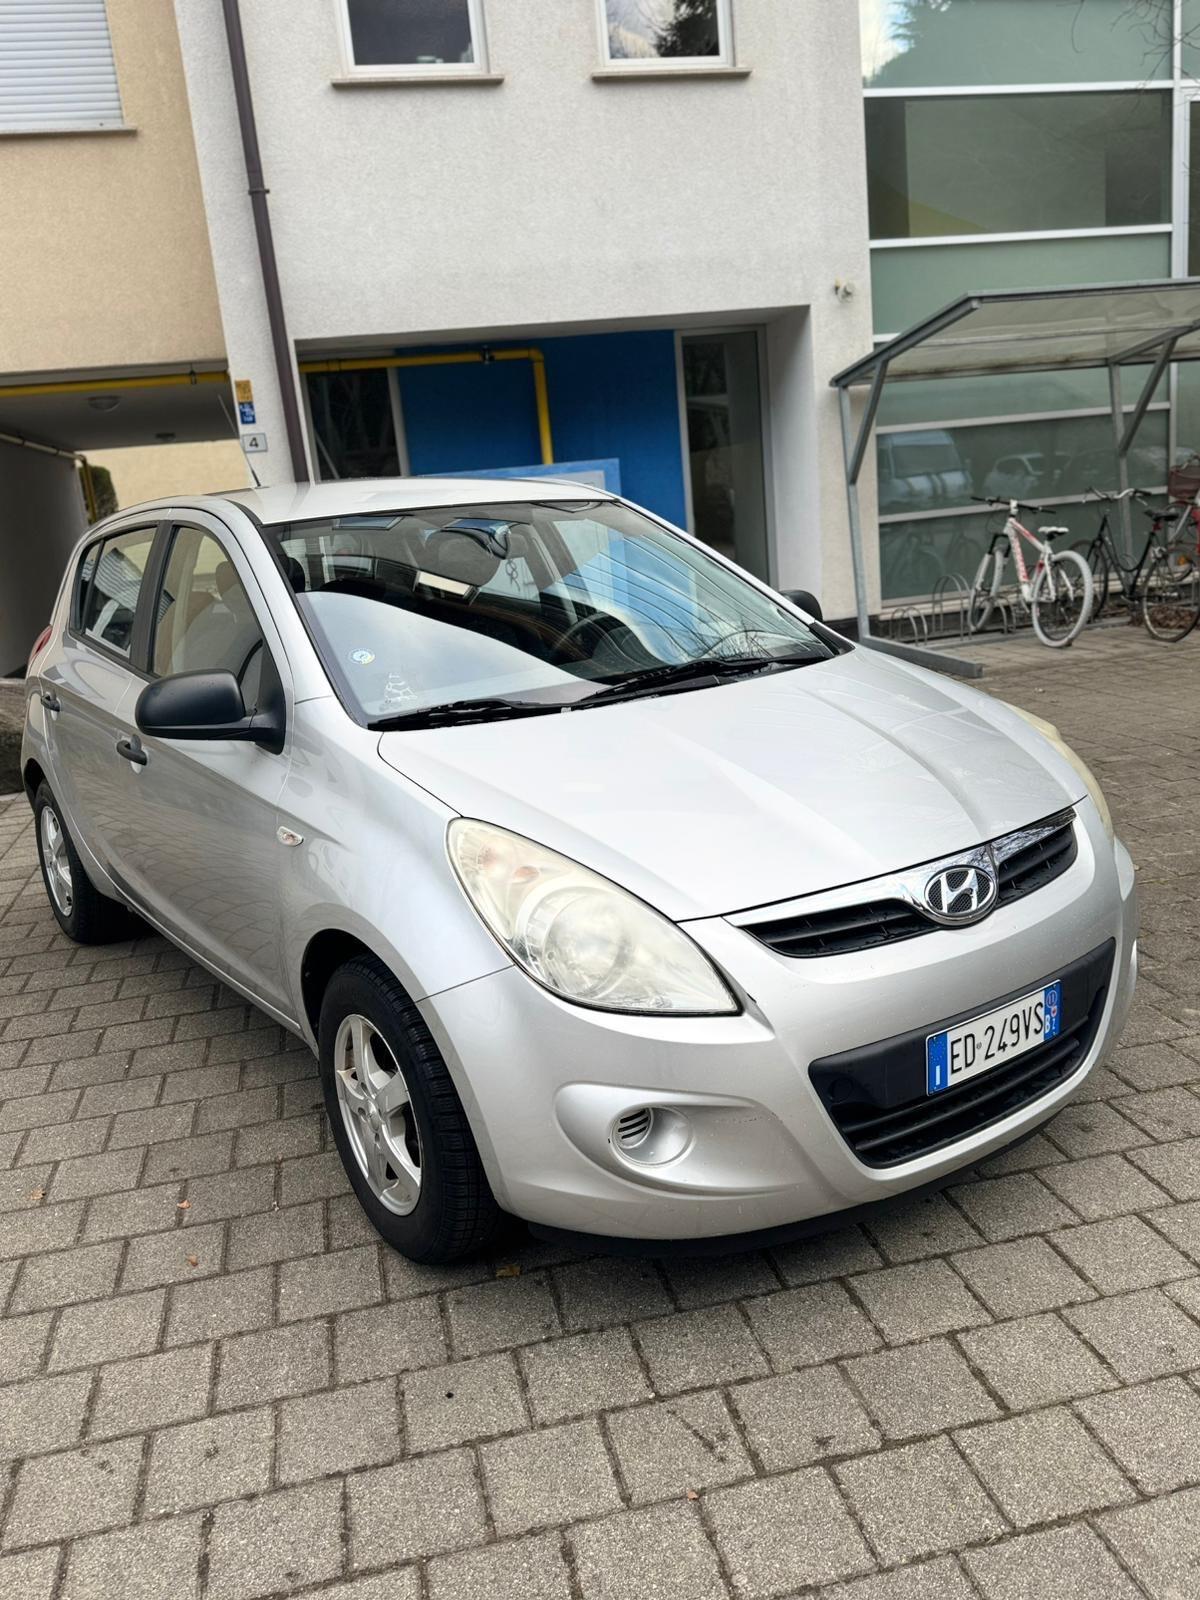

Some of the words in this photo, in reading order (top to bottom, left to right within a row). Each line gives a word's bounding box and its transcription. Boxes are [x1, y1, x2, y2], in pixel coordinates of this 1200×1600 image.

[249, 437, 259, 448] 4
[950, 1033, 976, 1074] ED
[984, 1001, 1044, 1060] 249VS
